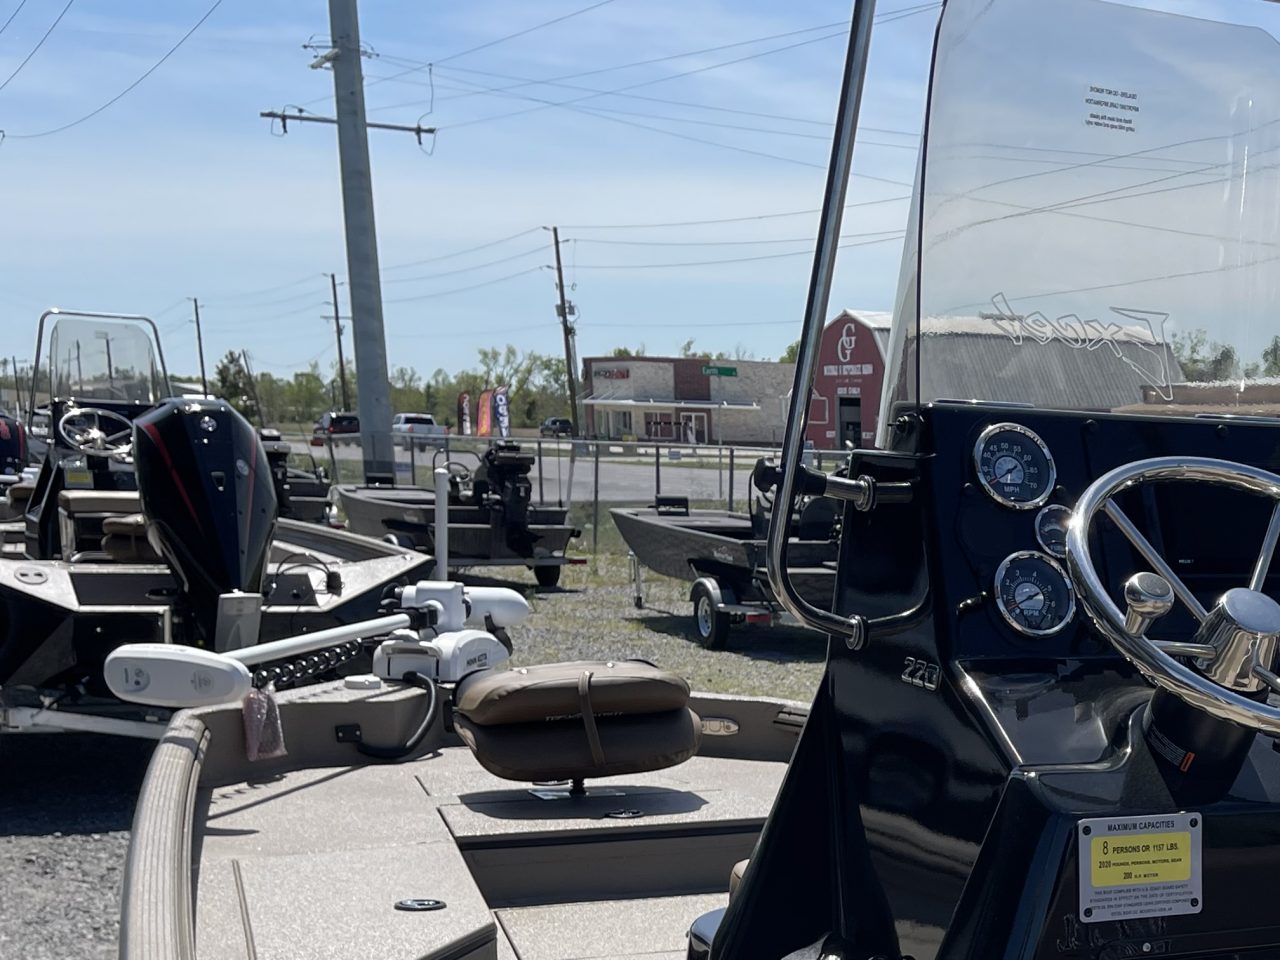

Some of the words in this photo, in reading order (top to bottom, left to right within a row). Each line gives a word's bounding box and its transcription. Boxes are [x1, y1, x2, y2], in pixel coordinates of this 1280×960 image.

[1004, 485, 1020, 493] MPH
[901, 656, 940, 691] 220
[1107, 822, 1138, 832] MAXIMUM
[1138, 820, 1175, 830] CAPACITIES
[1102, 840, 1109, 856] 8
[1112, 845, 1141, 855] PERSONS
[1141, 844, 1151, 853] OR
